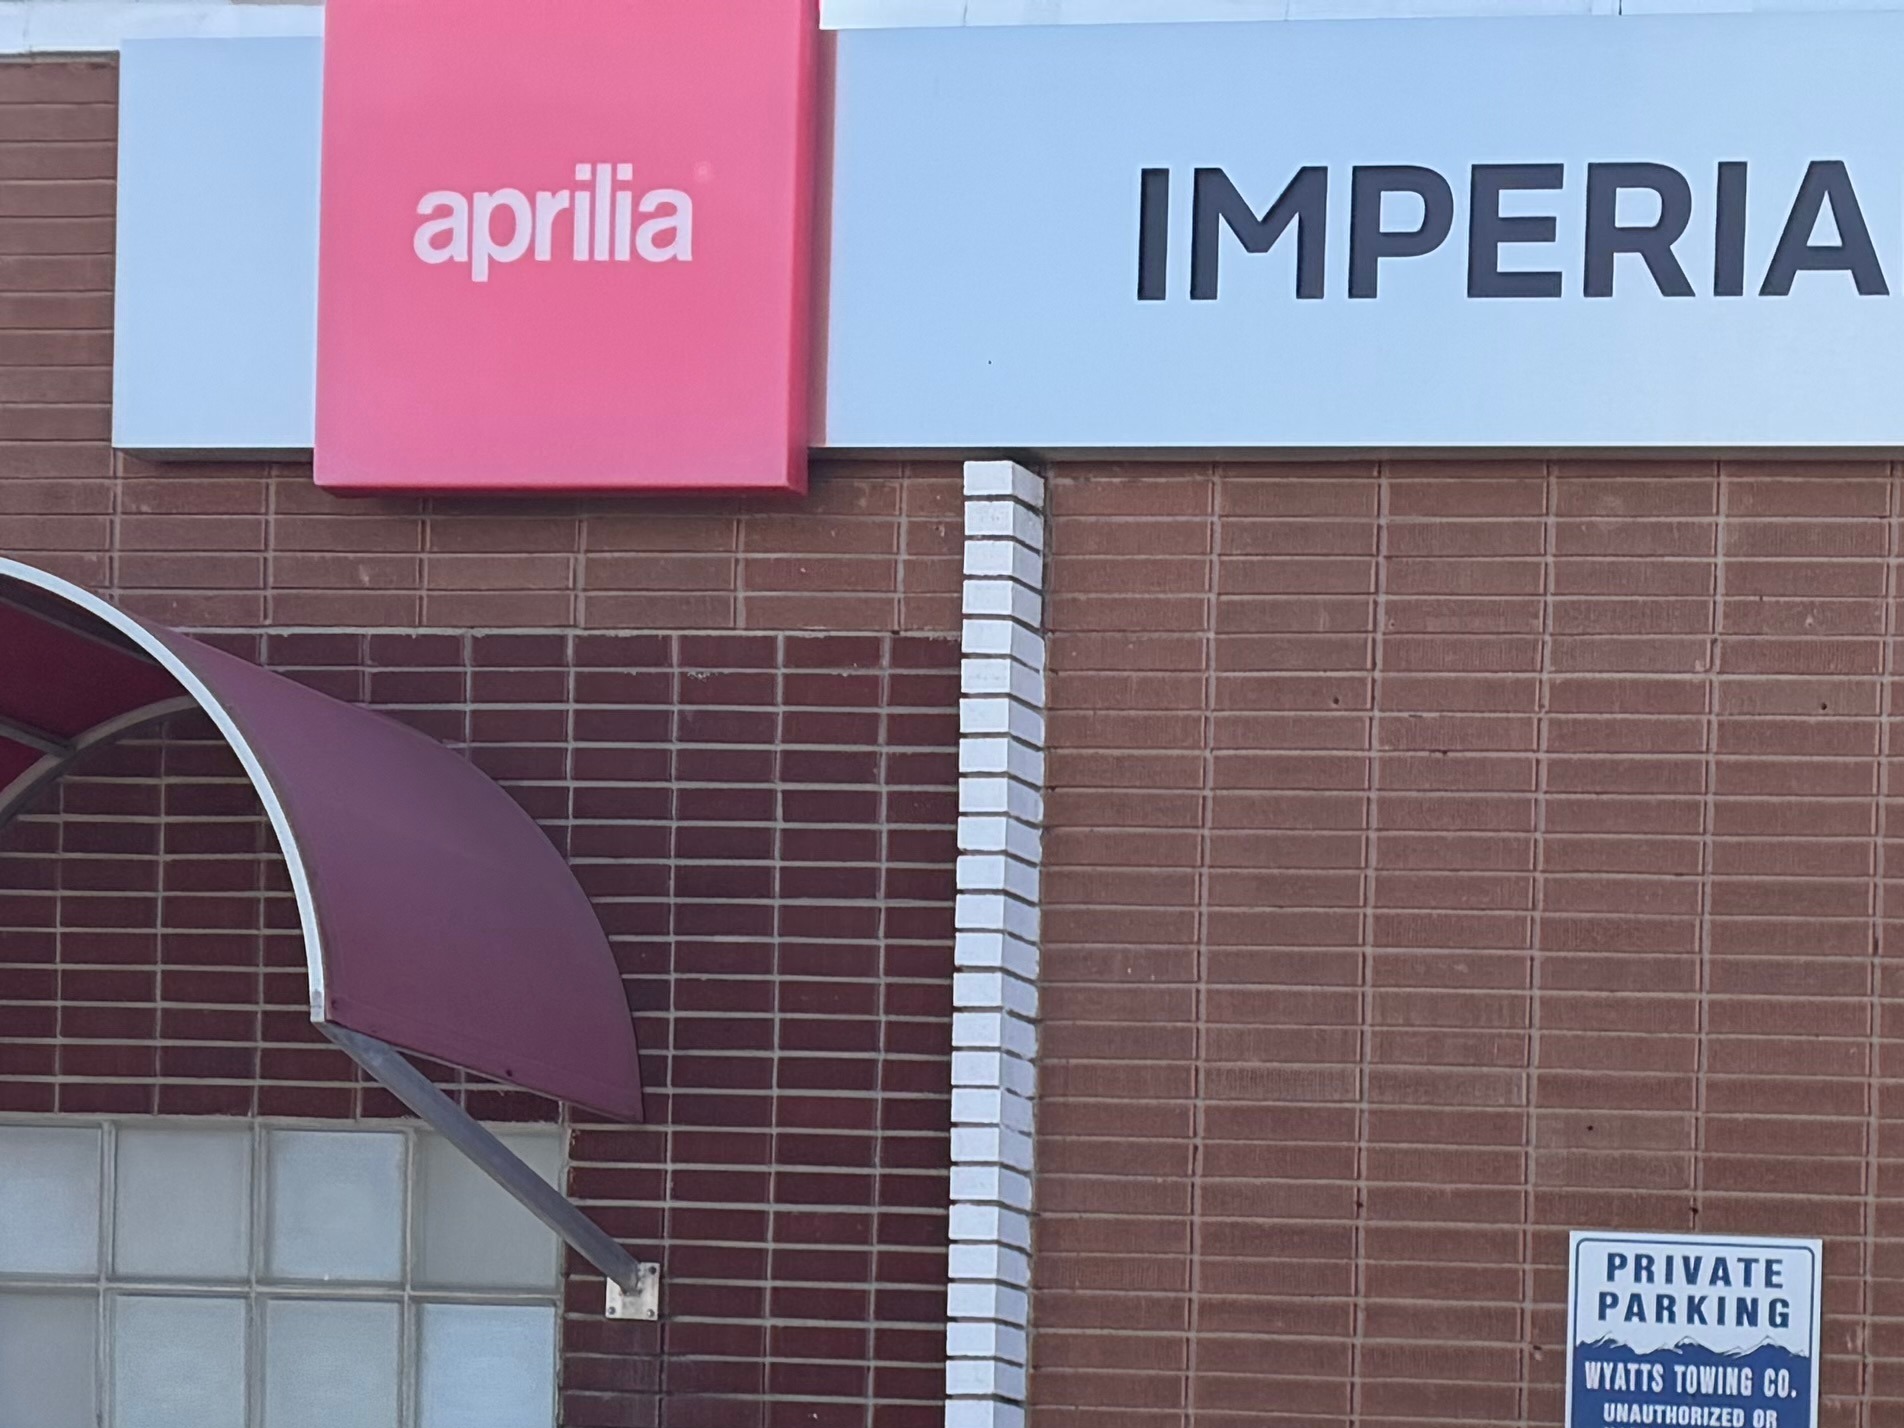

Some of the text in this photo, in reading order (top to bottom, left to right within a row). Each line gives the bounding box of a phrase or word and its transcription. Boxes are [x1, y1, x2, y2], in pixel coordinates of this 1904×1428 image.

[411, 160, 695, 284] aprilia
[1606, 1253, 1784, 1289] PRIVATE
[1598, 1291, 1790, 1329] PARKING
[1584, 1361, 1798, 1398] WYATTS TOWING CO.
[1603, 1403, 1777, 1428] UNAUTHORIZED OR
